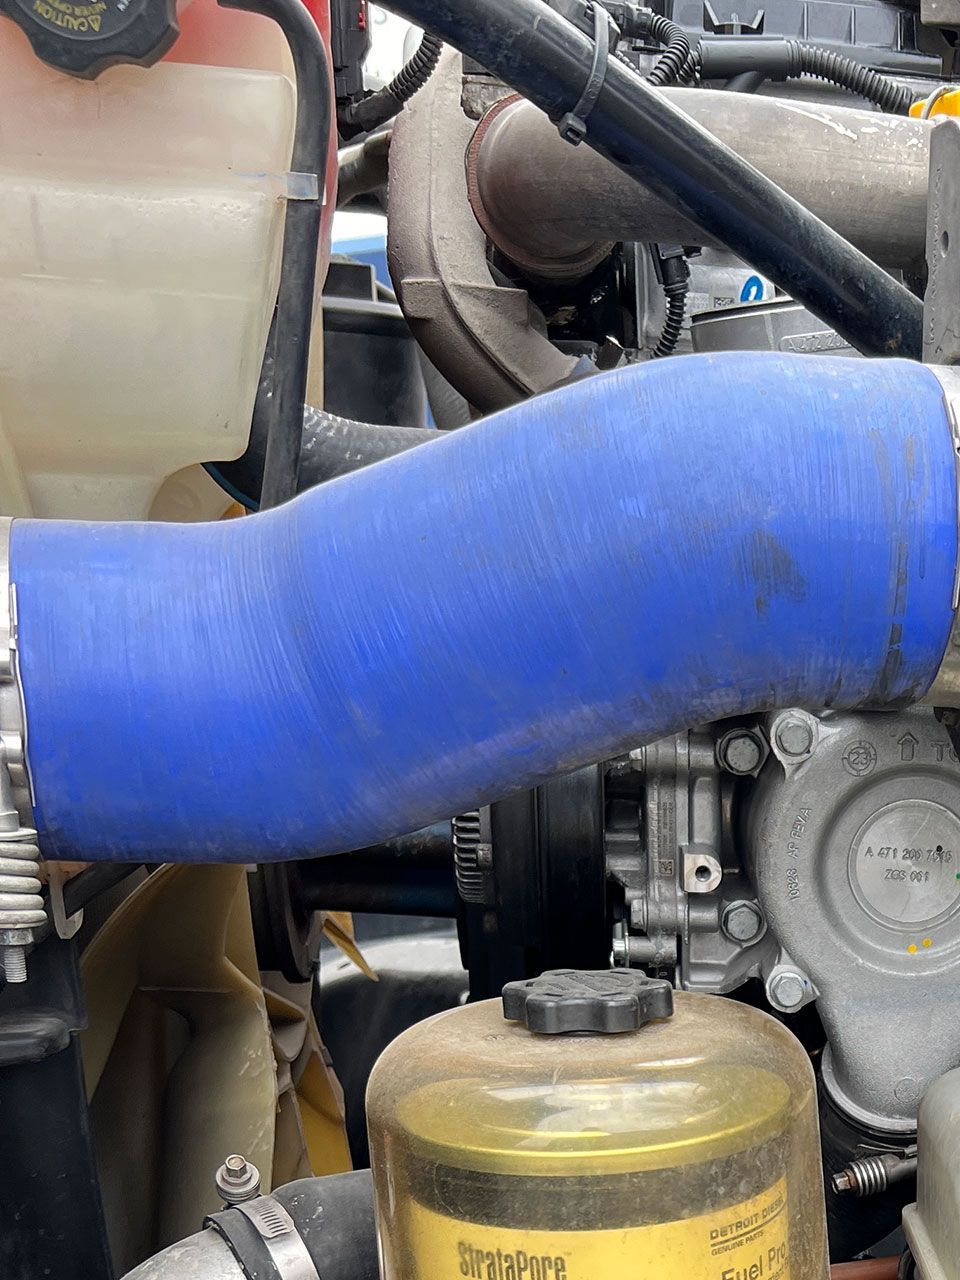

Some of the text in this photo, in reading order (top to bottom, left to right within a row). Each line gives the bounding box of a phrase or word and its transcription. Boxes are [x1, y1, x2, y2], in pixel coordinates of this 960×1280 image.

[33, 0, 92, 32] CAUTION
[709, 1213, 760, 1241] DETROIT
[767, 1240, 787, 1271] Pro
